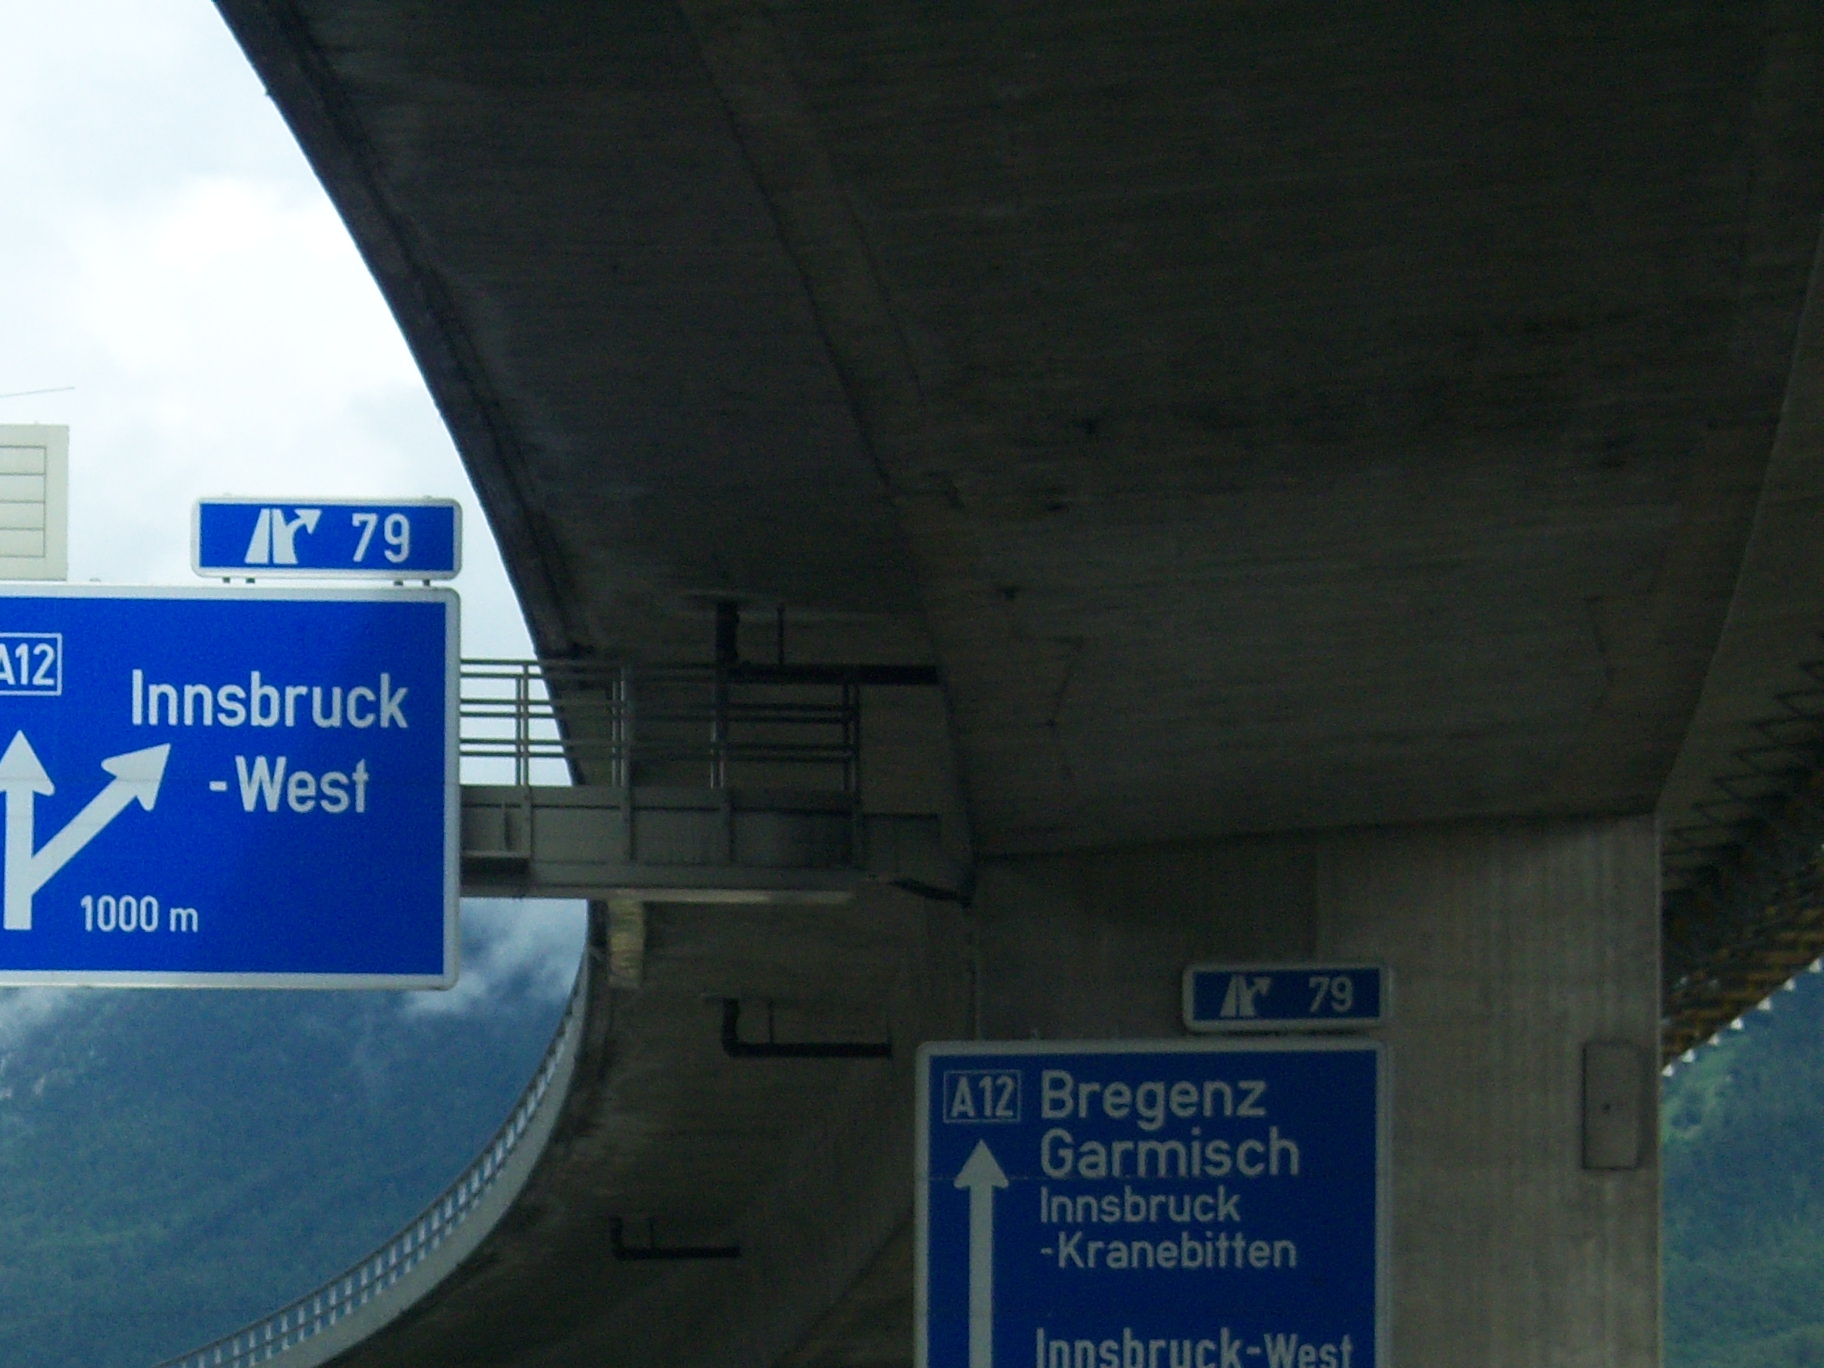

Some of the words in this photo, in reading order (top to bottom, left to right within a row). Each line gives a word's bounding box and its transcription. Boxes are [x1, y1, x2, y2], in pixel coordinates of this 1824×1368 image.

[351, 512, 410, 563] 79
[132, 668, 408, 728] Innsbruck
[209, 755, 369, 813] -West
[80, 894, 159, 933] 1000
[1307, 976, 1354, 1013] 79
[950, 1075, 1014, 1119] A12
[1041, 1069, 1267, 1129] Bregenz
[1040, 1126, 1300, 1179] Garmisch
[1040, 1184, 1241, 1224] Innsbruck
[1040, 1230, 1297, 1269] -Kranebitten
